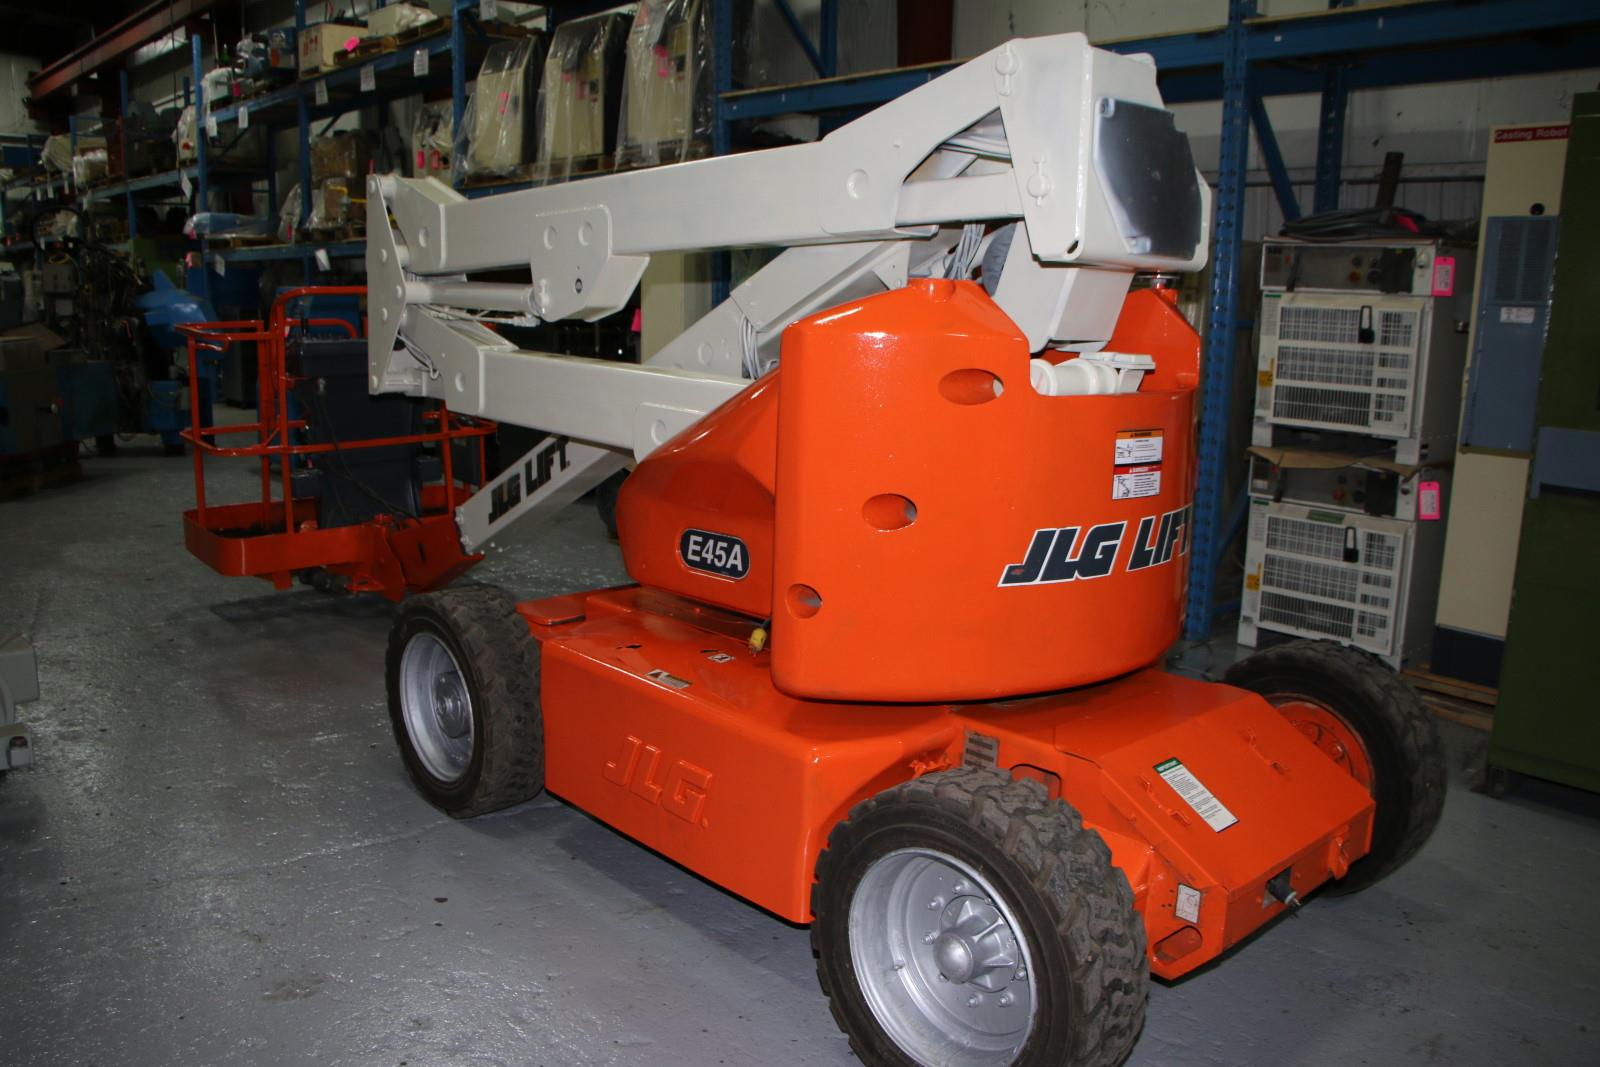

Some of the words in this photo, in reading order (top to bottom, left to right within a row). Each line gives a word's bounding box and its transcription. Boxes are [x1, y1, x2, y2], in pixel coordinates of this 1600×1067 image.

[1536, 127, 1568, 138] Robot
[488, 473, 522, 525] JLG
[525, 437, 569, 497] LIFT
[687, 535, 743, 572] E45A
[997, 520, 1128, 587] JLG
